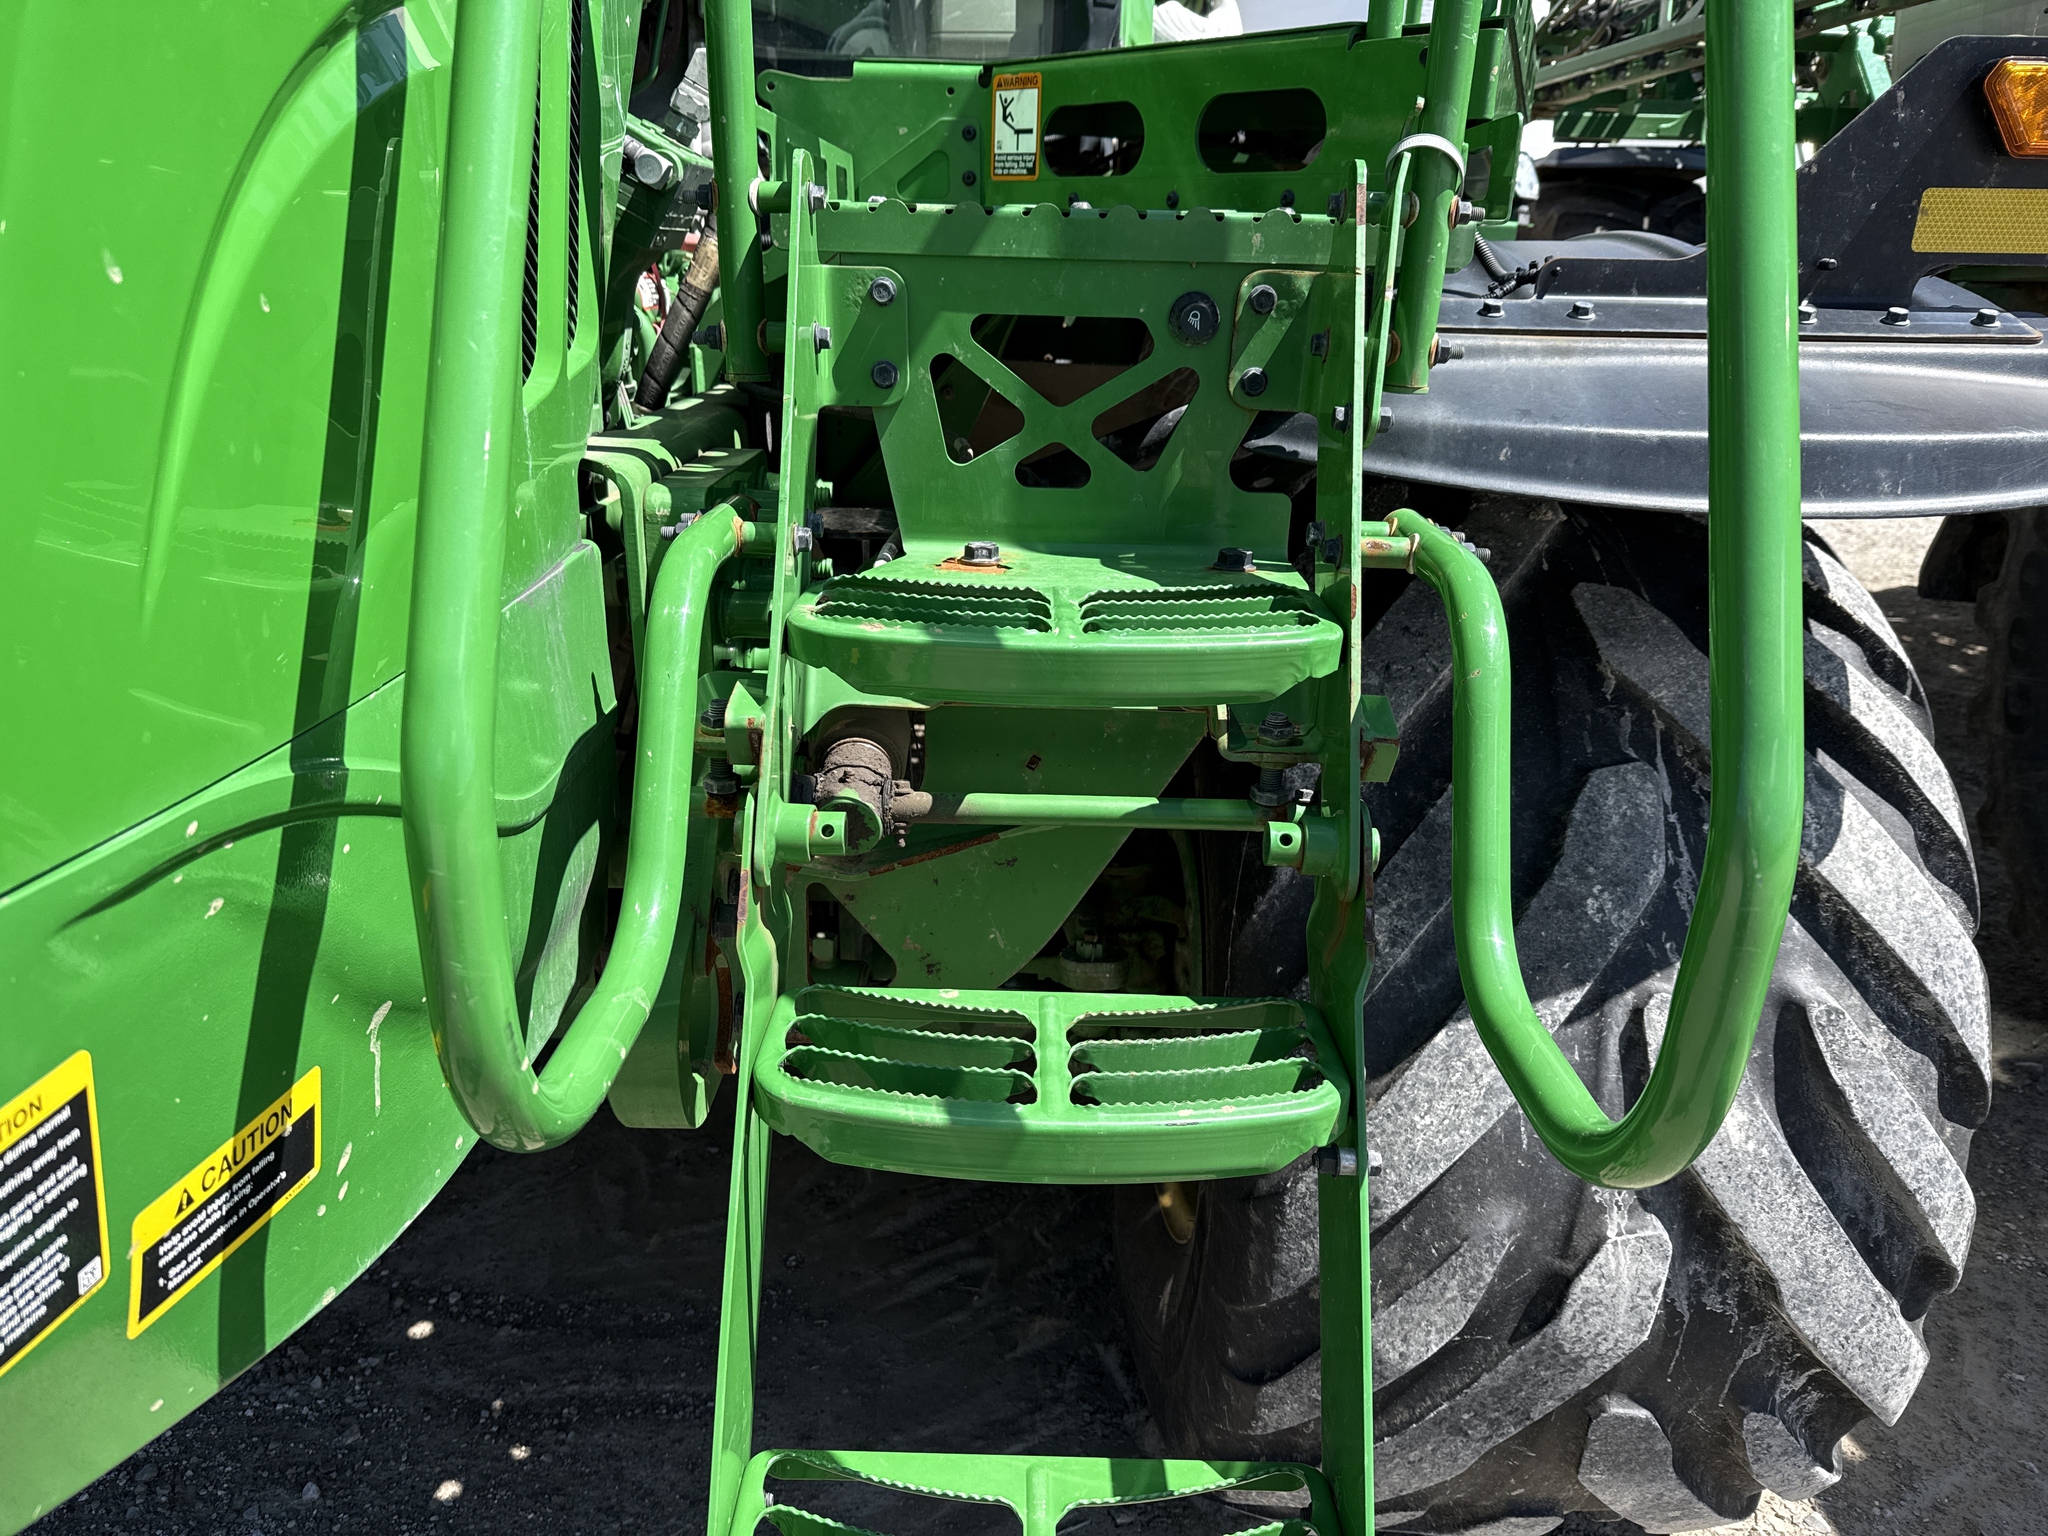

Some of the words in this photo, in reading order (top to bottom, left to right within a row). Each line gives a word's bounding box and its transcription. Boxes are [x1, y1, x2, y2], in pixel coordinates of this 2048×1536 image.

[1003, 75, 1038, 87] WARNING
[3, 1133, 38, 1165] during
[36, 1104, 72, 1140] normal
[31, 1145, 58, 1172] away
[57, 1127, 81, 1152] from
[201, 1097, 293, 1193] CAUTION
[9, 1190, 37, 1220] parts
[36, 1172, 57, 1197] and
[56, 1155, 79, 1181] shut
[32, 1198, 45, 1214] or
[44, 1163, 88, 1204] servicing
[158, 1231, 181, 1256] Help
[181, 1208, 207, 1236] avoid
[207, 1189, 231, 1217] injury
[232, 1173, 251, 1193] from
[251, 1151, 276, 1176] falling
[34, 1207, 68, 1240] engine
[66, 1199, 79, 1213] to
[158, 1230, 198, 1268] machine
[198, 1210, 221, 1236] while
[221, 1182, 254, 1217] jacking:
[168, 1258, 187, 1279] See
[187, 1214, 238, 1263] instructions
[238, 1206, 248, 1218] in
[248, 1170, 287, 1209] Operator's
[41, 1233, 69, 1263] parts
[167, 1256, 203, 1291] Manual.
[17, 1289, 35, 1309] are
[34, 1268, 59, 1294] clear
[58, 1255, 71, 1273] of
[0, 1314, 21, 1337] and
[4, 1304, 47, 1347] machine
